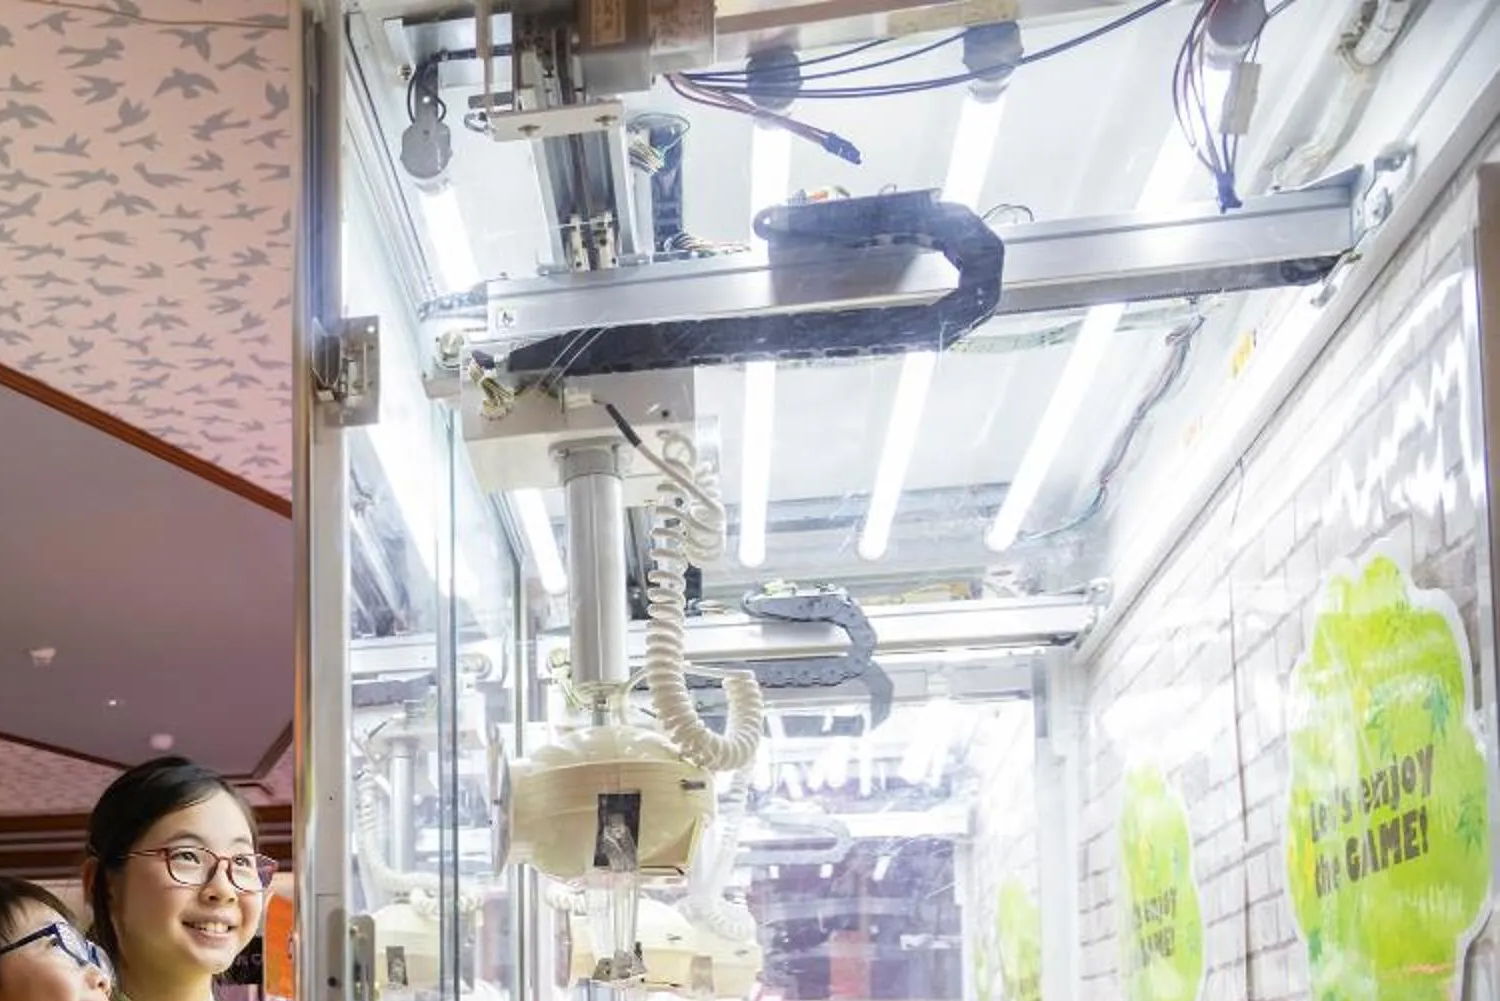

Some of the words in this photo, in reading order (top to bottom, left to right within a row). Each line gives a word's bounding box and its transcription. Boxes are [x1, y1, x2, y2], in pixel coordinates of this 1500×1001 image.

[1360, 744, 1434, 815] enjoy
[1316, 852, 1341, 898] the
[1346, 805, 1428, 882] GAME!
